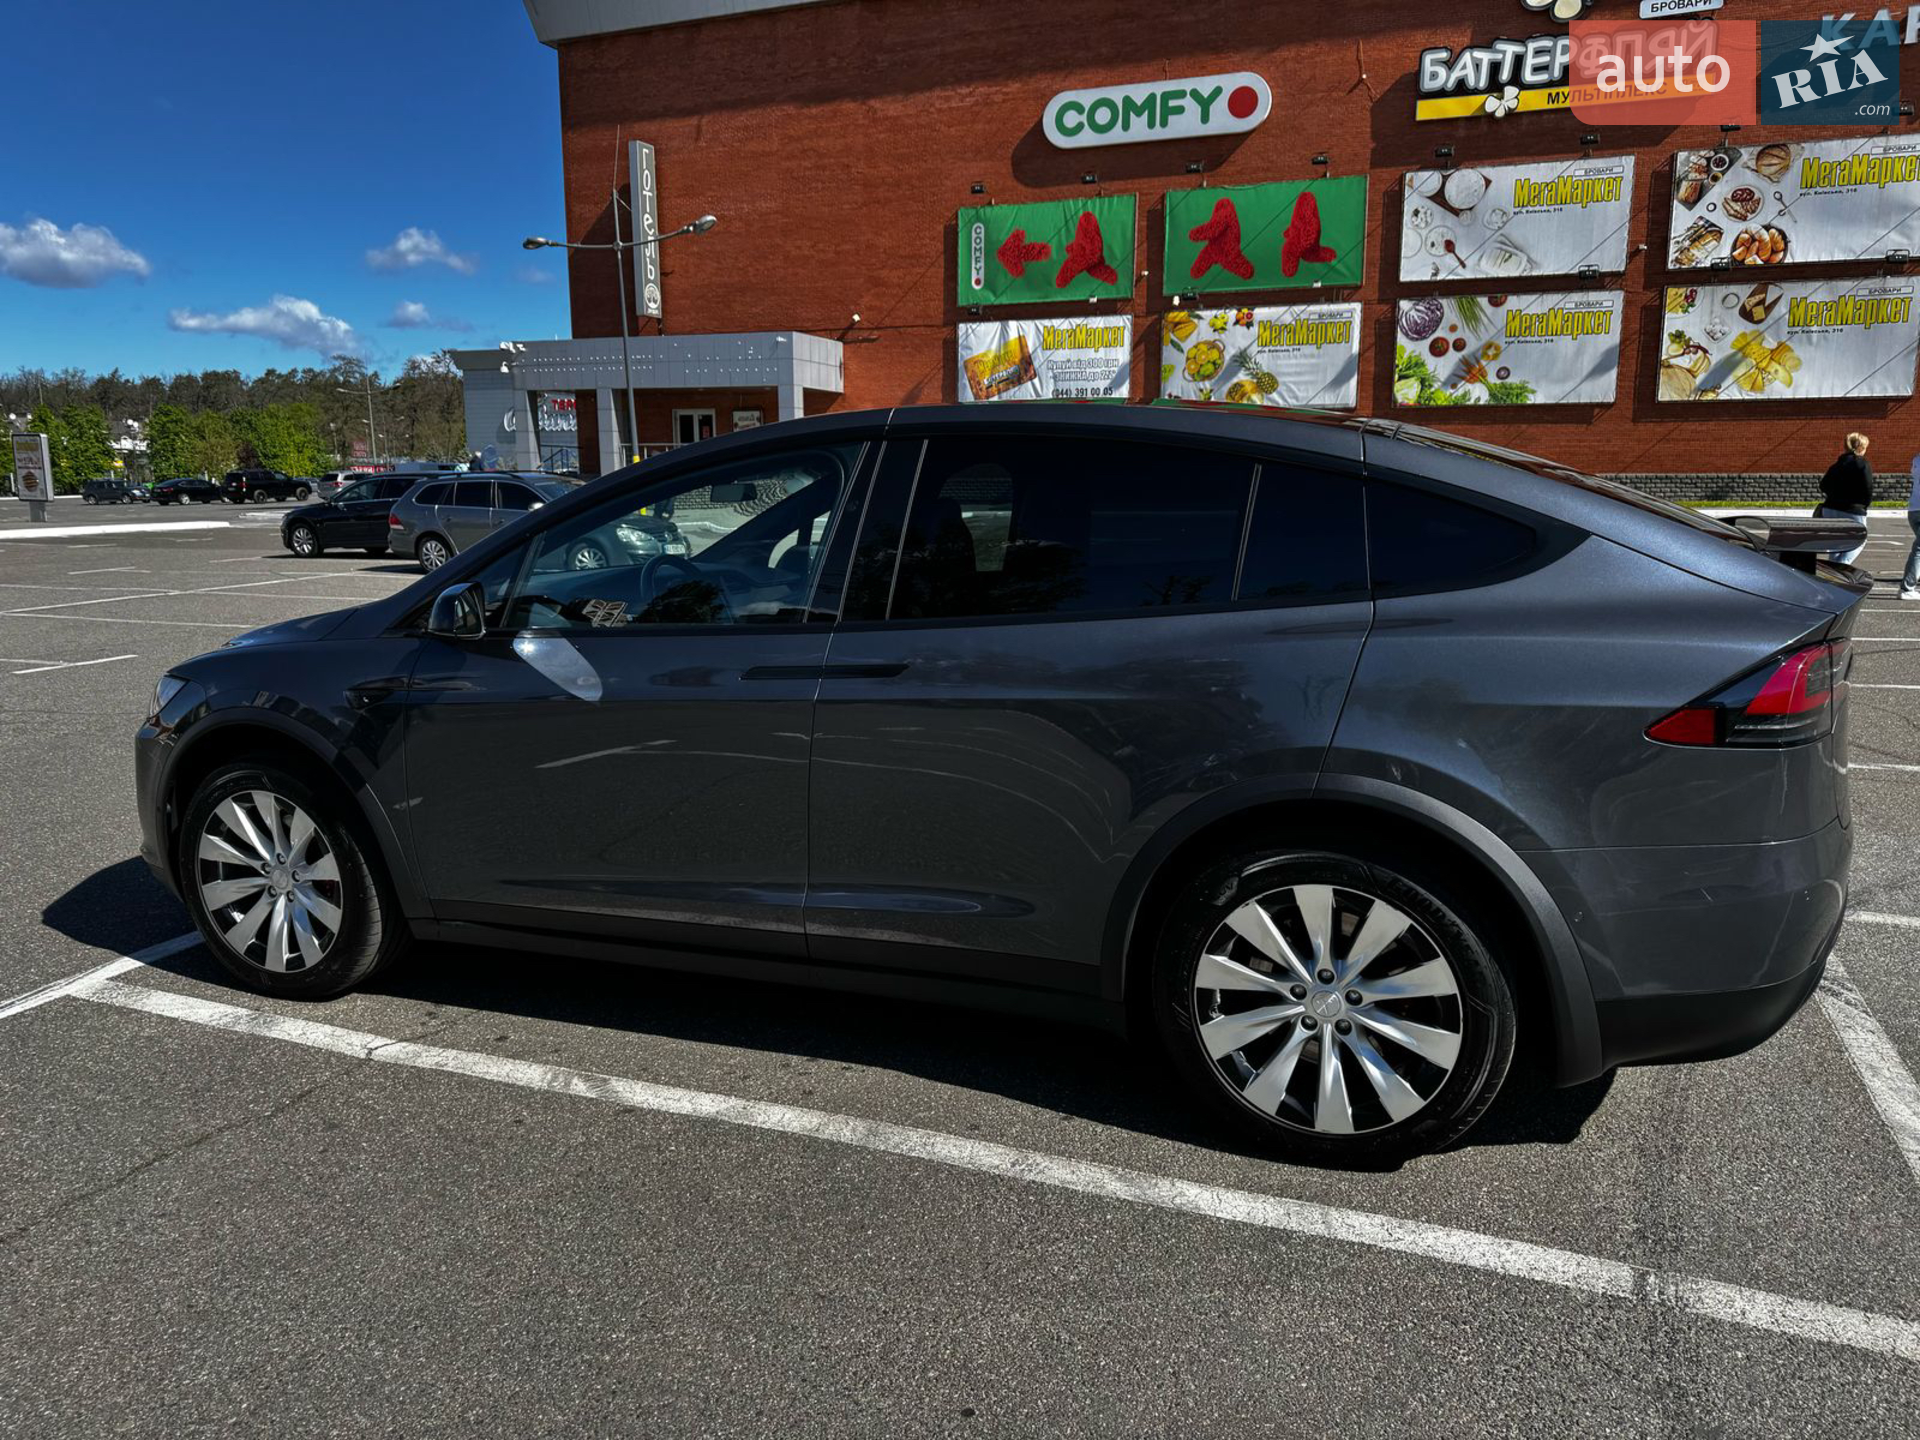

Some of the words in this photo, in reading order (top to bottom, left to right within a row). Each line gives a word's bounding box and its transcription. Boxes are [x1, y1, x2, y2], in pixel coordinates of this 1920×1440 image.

[1055, 86, 1223, 138] COMFY
[1800, 153, 1920, 189] МегаМарке
[1513, 175, 1624, 209] МегаМаркет
[974, 225, 982, 276] COMFY
[1505, 307, 1614, 340] МегаМаркет
[1788, 295, 1913, 329] МегаМаркет
[1042, 324, 1125, 353] МегаМаркет
[1257, 319, 1352, 349] МегаМаркет
[1087, 357, 1104, 368] 300
[1075, 387, 1088, 397] 391
[1090, 387, 1101, 396] 00
[1103, 386, 1113, 396] 05
